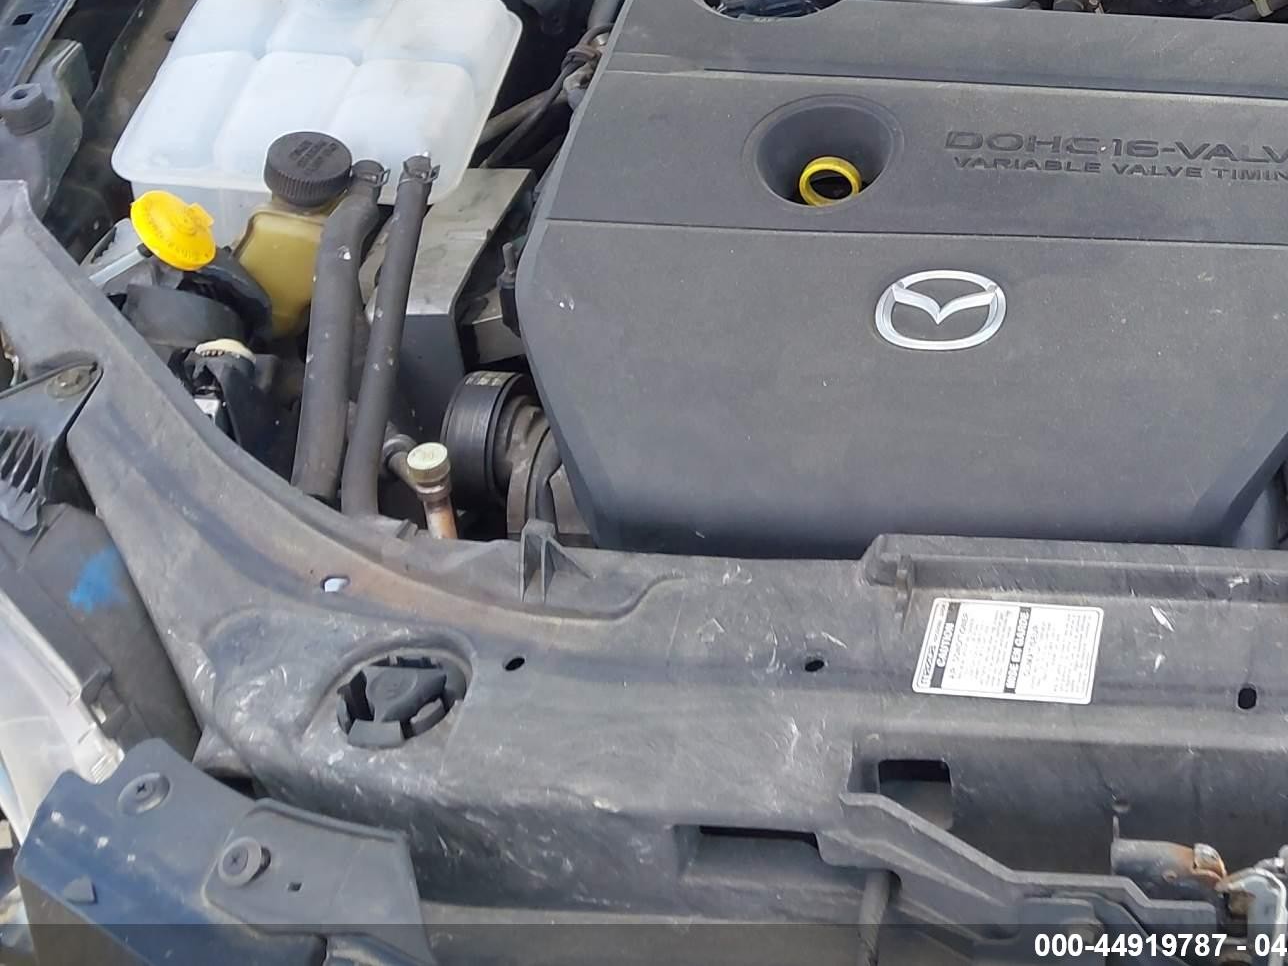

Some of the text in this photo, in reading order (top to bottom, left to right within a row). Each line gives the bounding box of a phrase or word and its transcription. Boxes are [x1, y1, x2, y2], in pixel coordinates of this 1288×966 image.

[944, 131, 1101, 155] DOHC
[953, 156, 1101, 173] VARIABLE
[1111, 163, 1203, 179] VALVE
[936, 622, 955, 667] CAUTION
